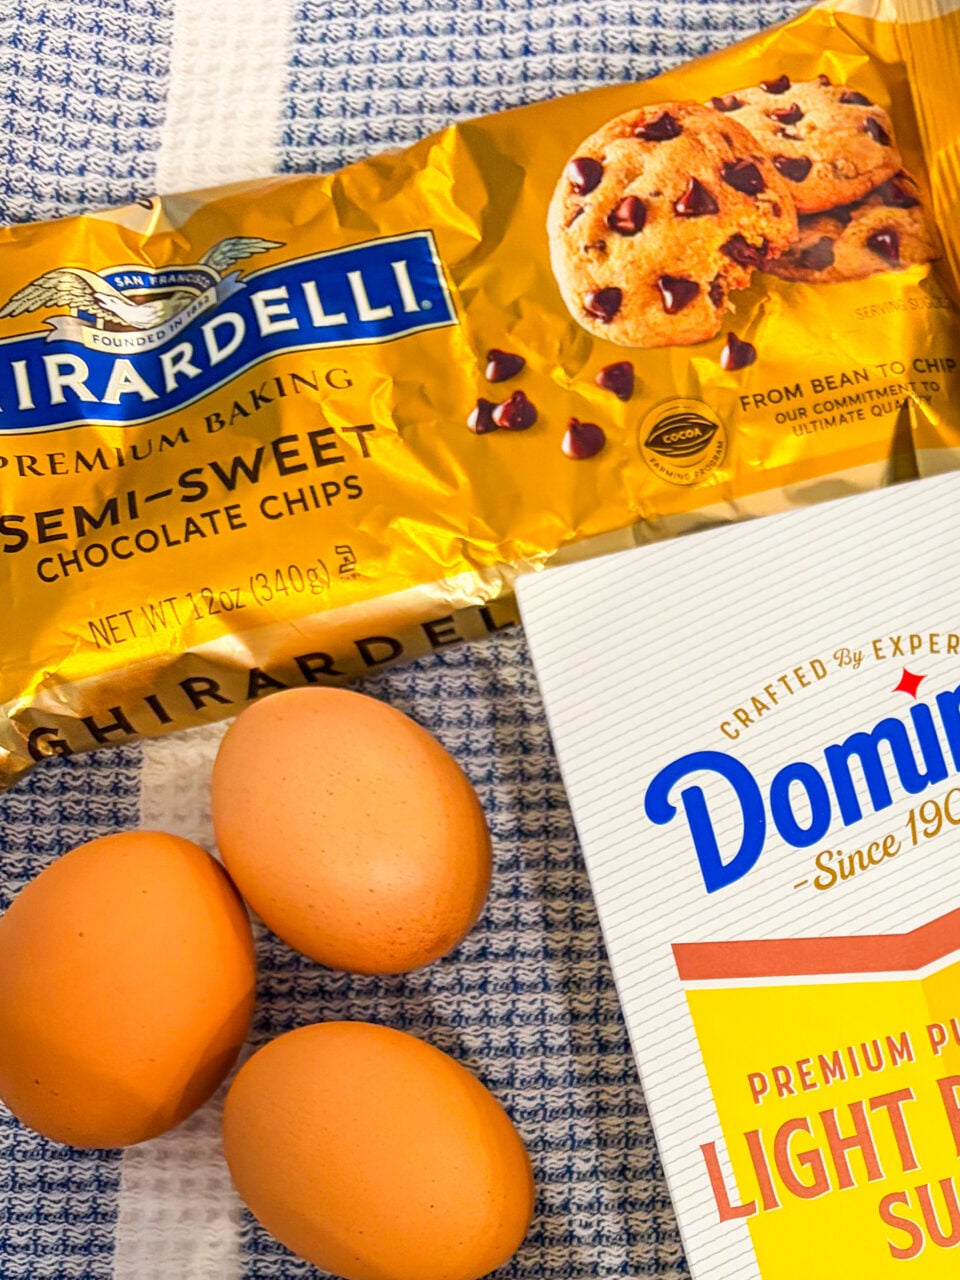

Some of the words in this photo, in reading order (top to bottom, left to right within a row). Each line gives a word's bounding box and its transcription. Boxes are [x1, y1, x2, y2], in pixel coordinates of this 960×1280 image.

[114, 276, 144, 287] SAN
[0, 261, 423, 412] IRARDELLI
[92, 330, 166, 347] FOUNDED
[169, 318, 183, 332] IN
[204, 368, 354, 434] BAKING
[740, 384, 804, 411] FROM
[810, 368, 869, 394] BEAN
[876, 361, 905, 377] TO
[913, 358, 956, 373] CHIP
[775, 409, 808, 424] OUR
[812, 381, 916, 415] COMMITMENT
[921, 381, 940, 392] TO
[663, 428, 702, 443] COCOA
[792, 409, 865, 437] ULTIMATE
[36, 504, 247, 583] CHOCOLATE
[259, 474, 363, 521] CHIPS
[88, 609, 134, 649] NET
[144, 597, 181, 632] WT
[192, 586, 244, 623] 12oz
[249, 559, 330, 607] (340g)
[720, 658, 828, 740] CRAFTED
[833, 647, 865, 669] By
[747, 1031, 915, 1104] PREMIUM
[700, 1087, 920, 1222] LIGHT
